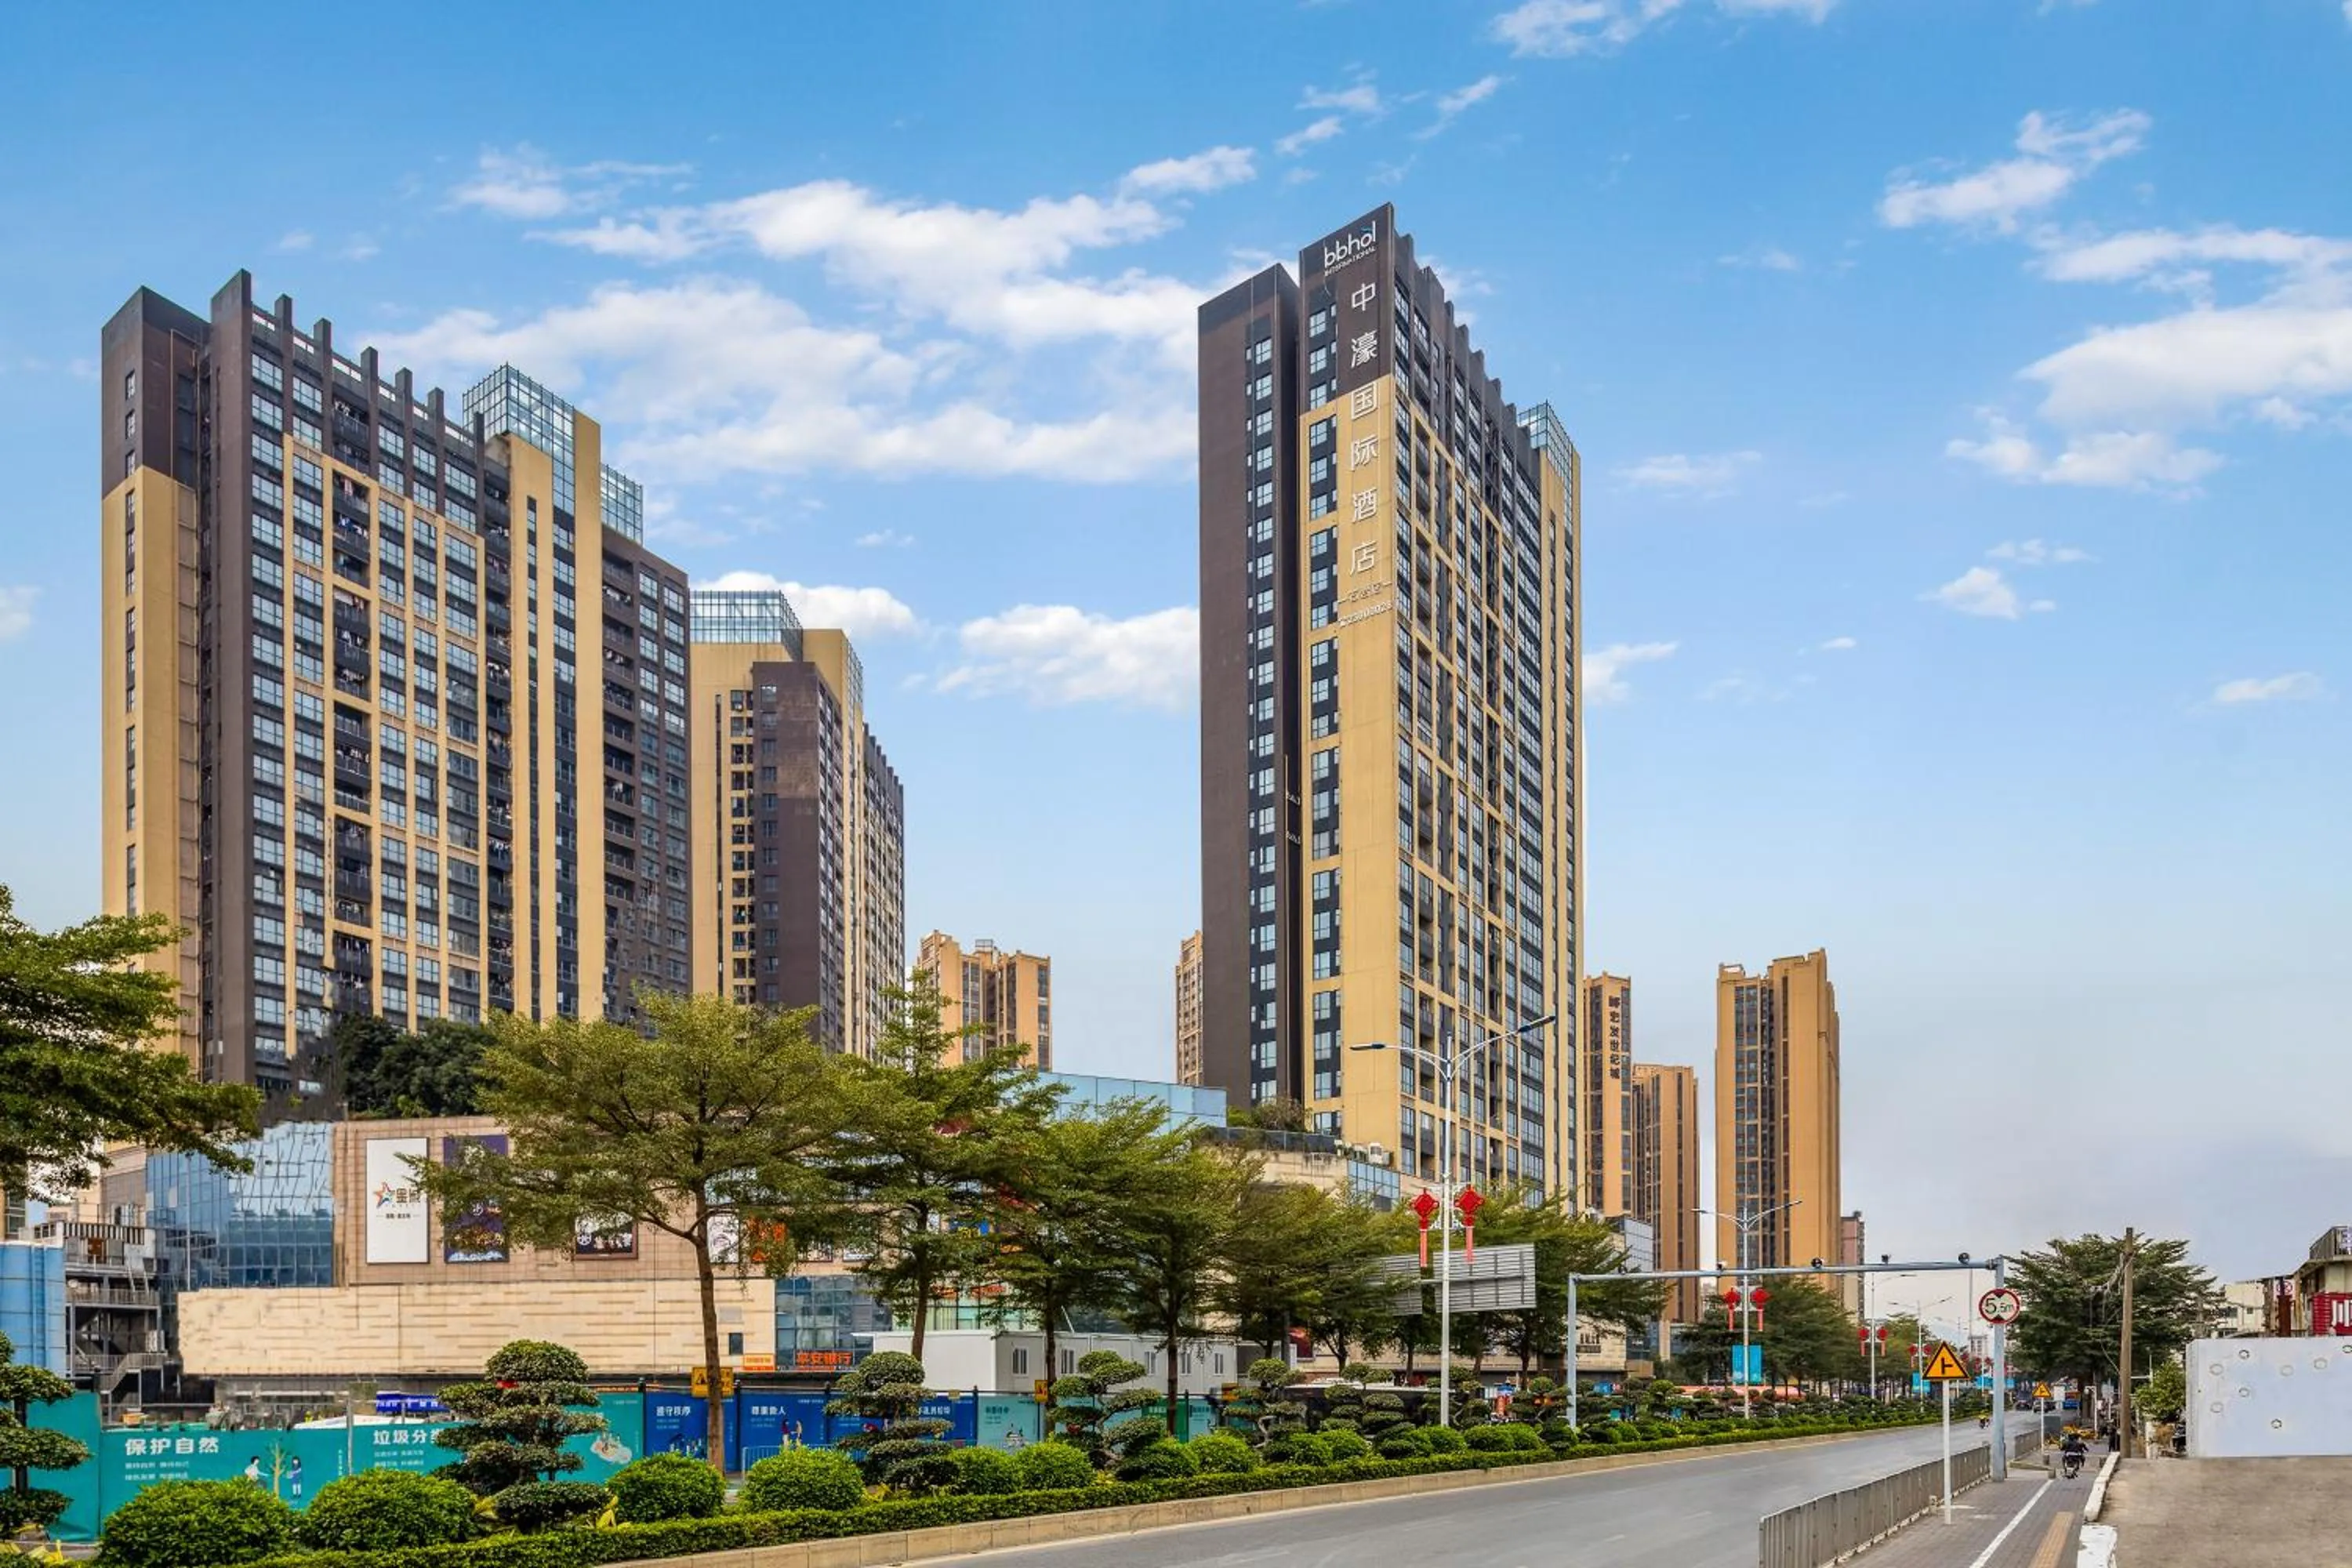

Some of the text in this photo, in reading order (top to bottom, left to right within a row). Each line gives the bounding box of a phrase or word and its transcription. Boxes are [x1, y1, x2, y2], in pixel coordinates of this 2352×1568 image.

[1324, 220, 1376, 268] bbhol
[1349, 282, 1379, 576] 中濠国际酒店
[125, 1436, 220, 1456] 保护自然
